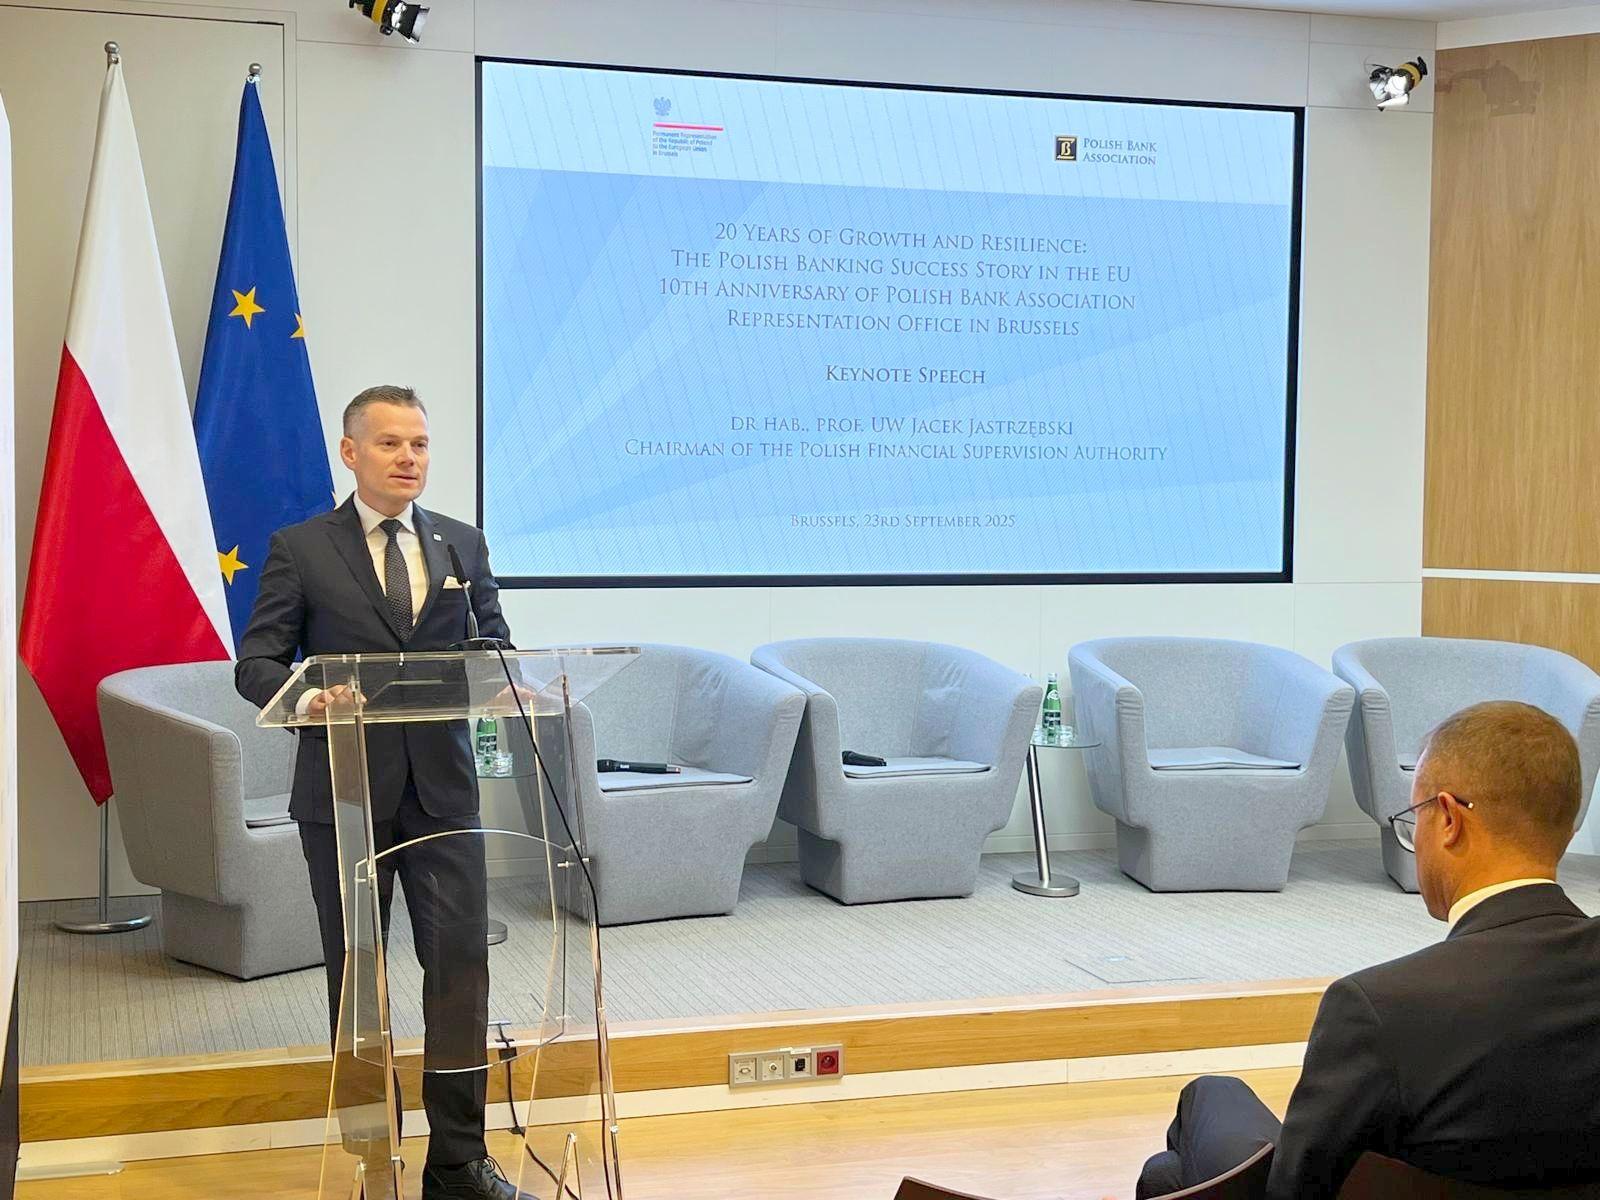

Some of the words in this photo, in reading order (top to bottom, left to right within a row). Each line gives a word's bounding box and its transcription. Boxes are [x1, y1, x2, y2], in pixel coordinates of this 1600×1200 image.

[1083, 138, 1122, 149] POLISH
[1128, 140, 1157, 152] BANK
[1083, 152, 1156, 165] ASSOCIATION
[715, 223, 737, 240] 20
[743, 224, 800, 243] YEARS
[808, 229, 831, 244] OF
[839, 228, 926, 248] GROWTH
[933, 234, 974, 249] AND
[981, 234, 1087, 253] RESILIENCE:
[671, 249, 711, 268] THE
[719, 252, 787, 271] POLISH
[797, 255, 883, 275] BANKING
[891, 258, 968, 277] SUCCESS
[976, 261, 1033, 279] STORY
[1039, 265, 1058, 279] IN
[1066, 266, 1099, 281] THE
[1108, 266, 1131, 282] EU
[660, 278, 708, 296] 10TH
[715, 280, 849, 301] ANNIVERSARY
[855, 287, 879, 302] OF
[887, 285, 951, 305] POLISH
[960, 288, 1009, 306] BANK
[1014, 290, 1136, 310] ASSOCIATION
[728, 310, 891, 331] REPRESENTATION
[898, 315, 962, 333] OFFICE
[970, 318, 990, 333] IN
[998, 318, 1079, 336] BRUSSELS
[825, 365, 912, 382] KEYNOTE
[919, 367, 986, 384] SPEECH
[731, 417, 757, 431] DR
[817, 418, 864, 432] PROF.
[872, 417, 905, 432] UW
[911, 418, 963, 437] JACEK
[968, 418, 1073, 438] JASTRZĘBSKI
[625, 439, 725, 456] CHAIRMAN
[731, 443, 753, 456] OF
[759, 443, 793, 457] THE
[800, 441, 860, 458] POLISH
[868, 443, 955, 459] FINANCIAL
[963, 444, 1068, 460] SUPERVISION
[1073, 446, 1168, 460] AUTHORITY
[864, 515, 900, 527] 23RD
[905, 515, 981, 527] SEPTEMBER
[985, 515, 1016, 527] 2025
